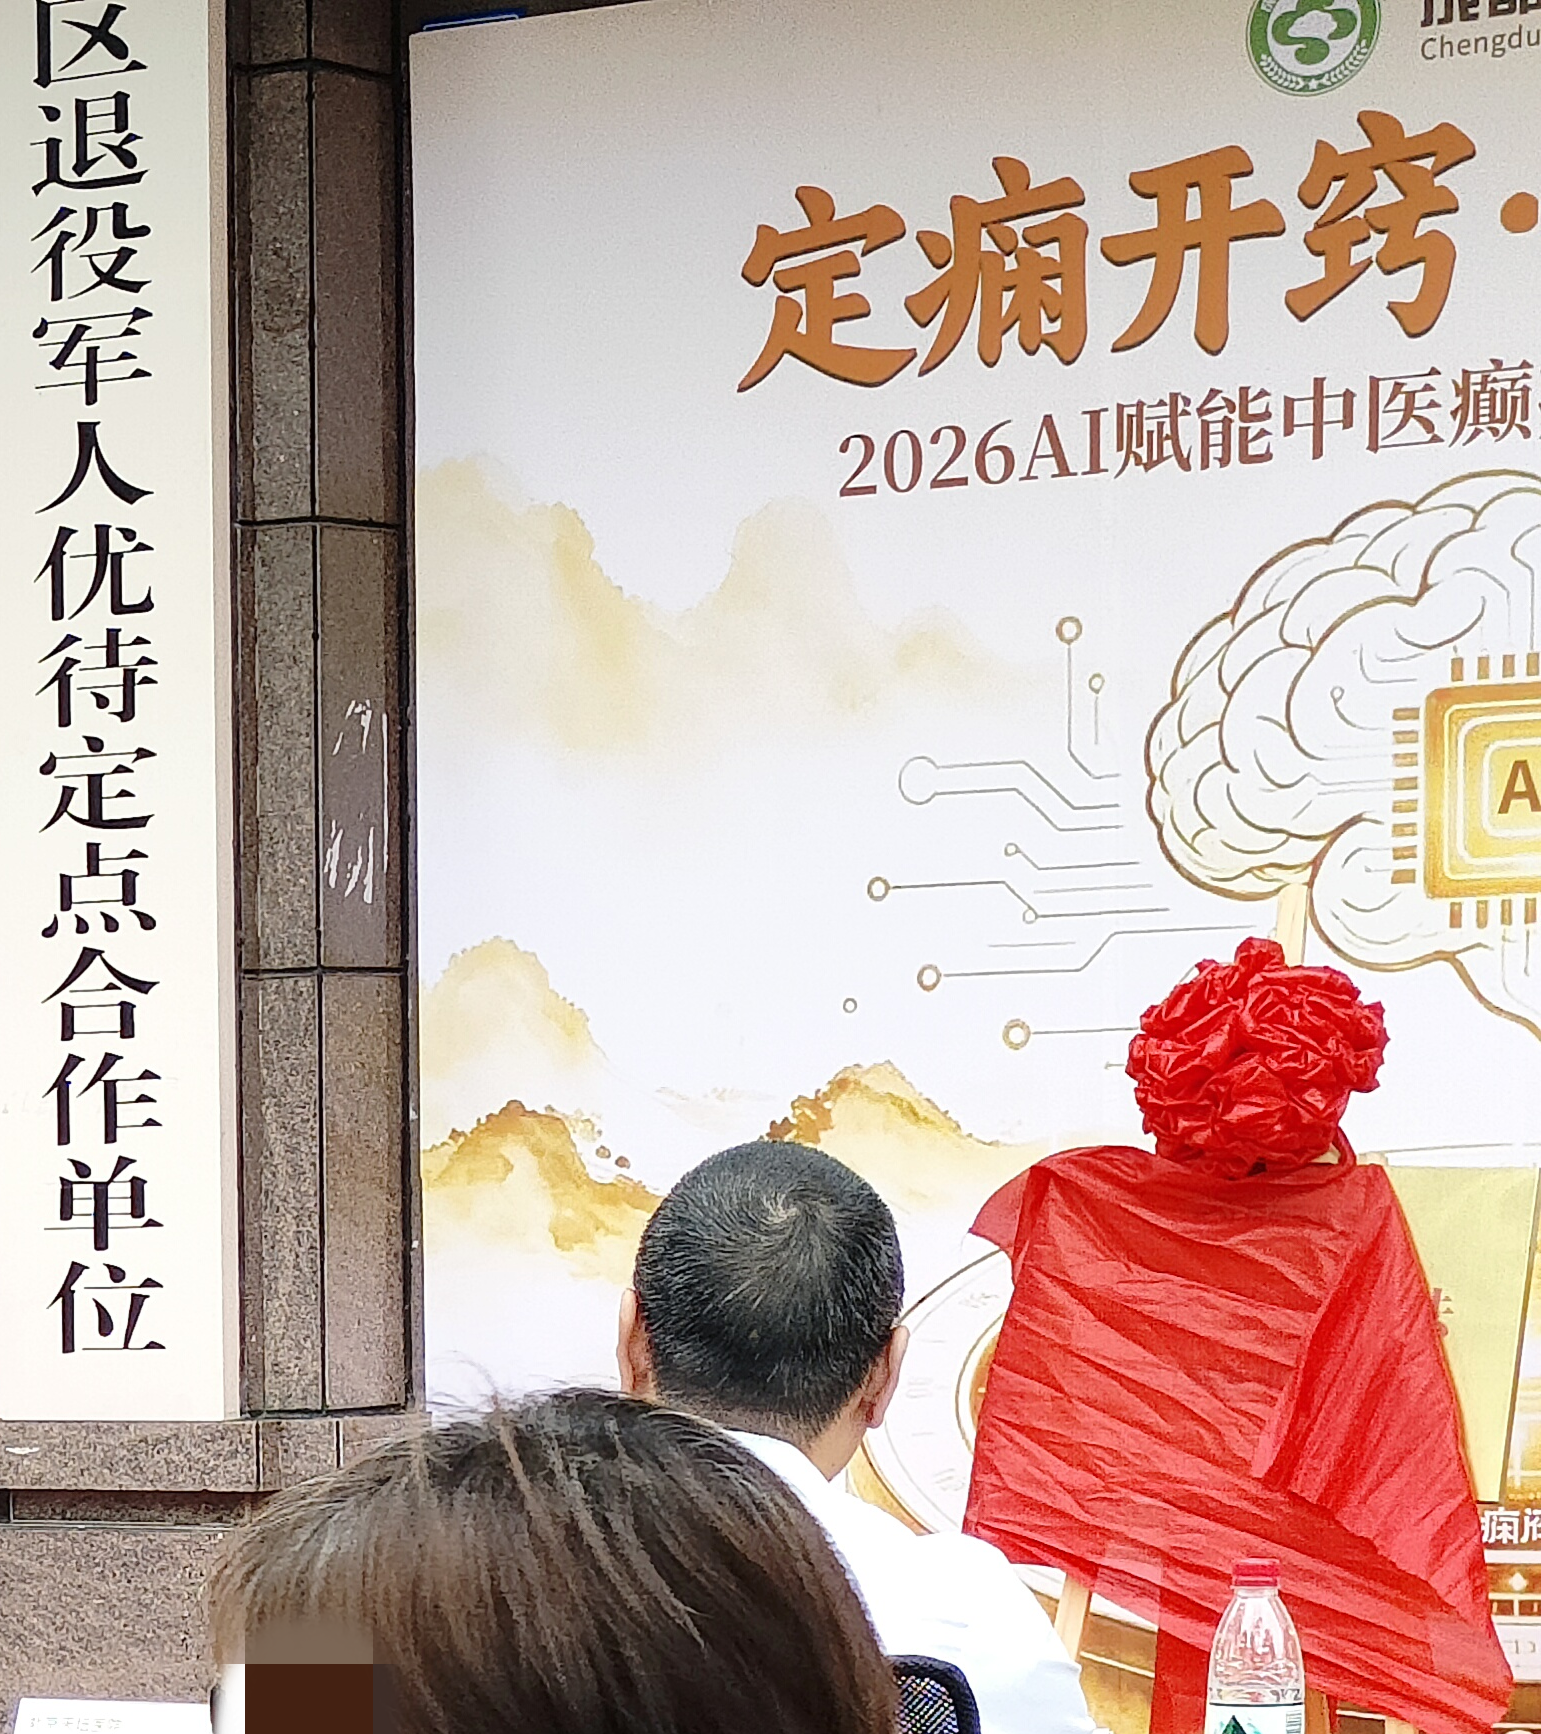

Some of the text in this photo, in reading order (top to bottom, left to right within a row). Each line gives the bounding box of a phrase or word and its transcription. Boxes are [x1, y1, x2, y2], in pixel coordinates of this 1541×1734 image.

[1421, 24, 1541, 60] Chengdu
[838, 358, 1541, 497] 2026AI赋能中医癫
[30, 0, 167, 1354] 区退役军人优待定点合作单位
